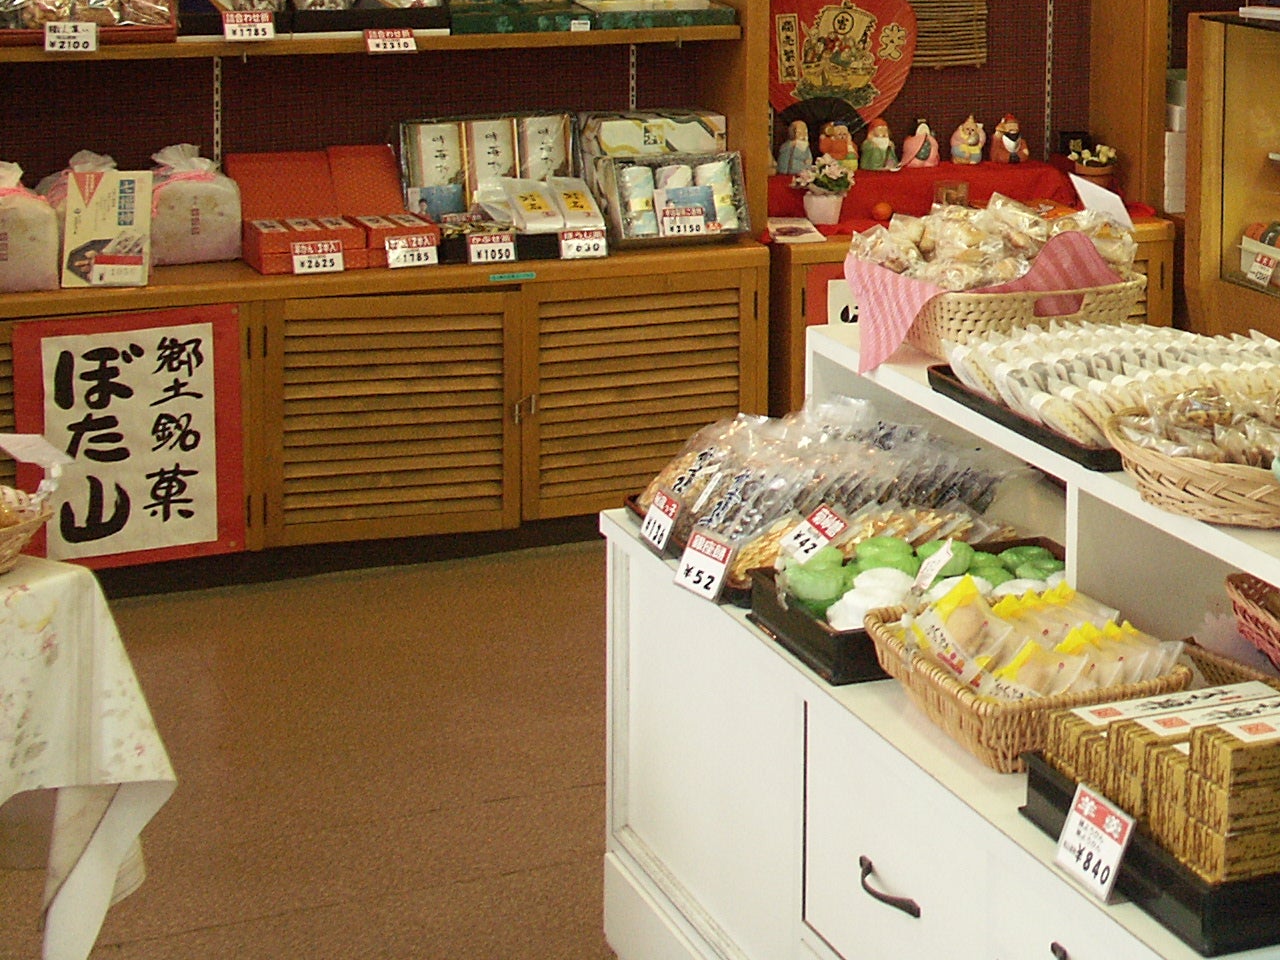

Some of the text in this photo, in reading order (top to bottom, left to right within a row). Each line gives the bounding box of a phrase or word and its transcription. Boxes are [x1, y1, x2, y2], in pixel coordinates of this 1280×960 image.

[300, 258, 336, 269] ¥2625
[477, 248, 511, 260] ¥1050
[143, 336, 204, 522] 郷土銘菓
[54, 343, 145, 544] ぼた山
[792, 530, 818, 555] ¥42
[683, 563, 716, 591] ¥52
[1074, 843, 1111, 886] ¥840
